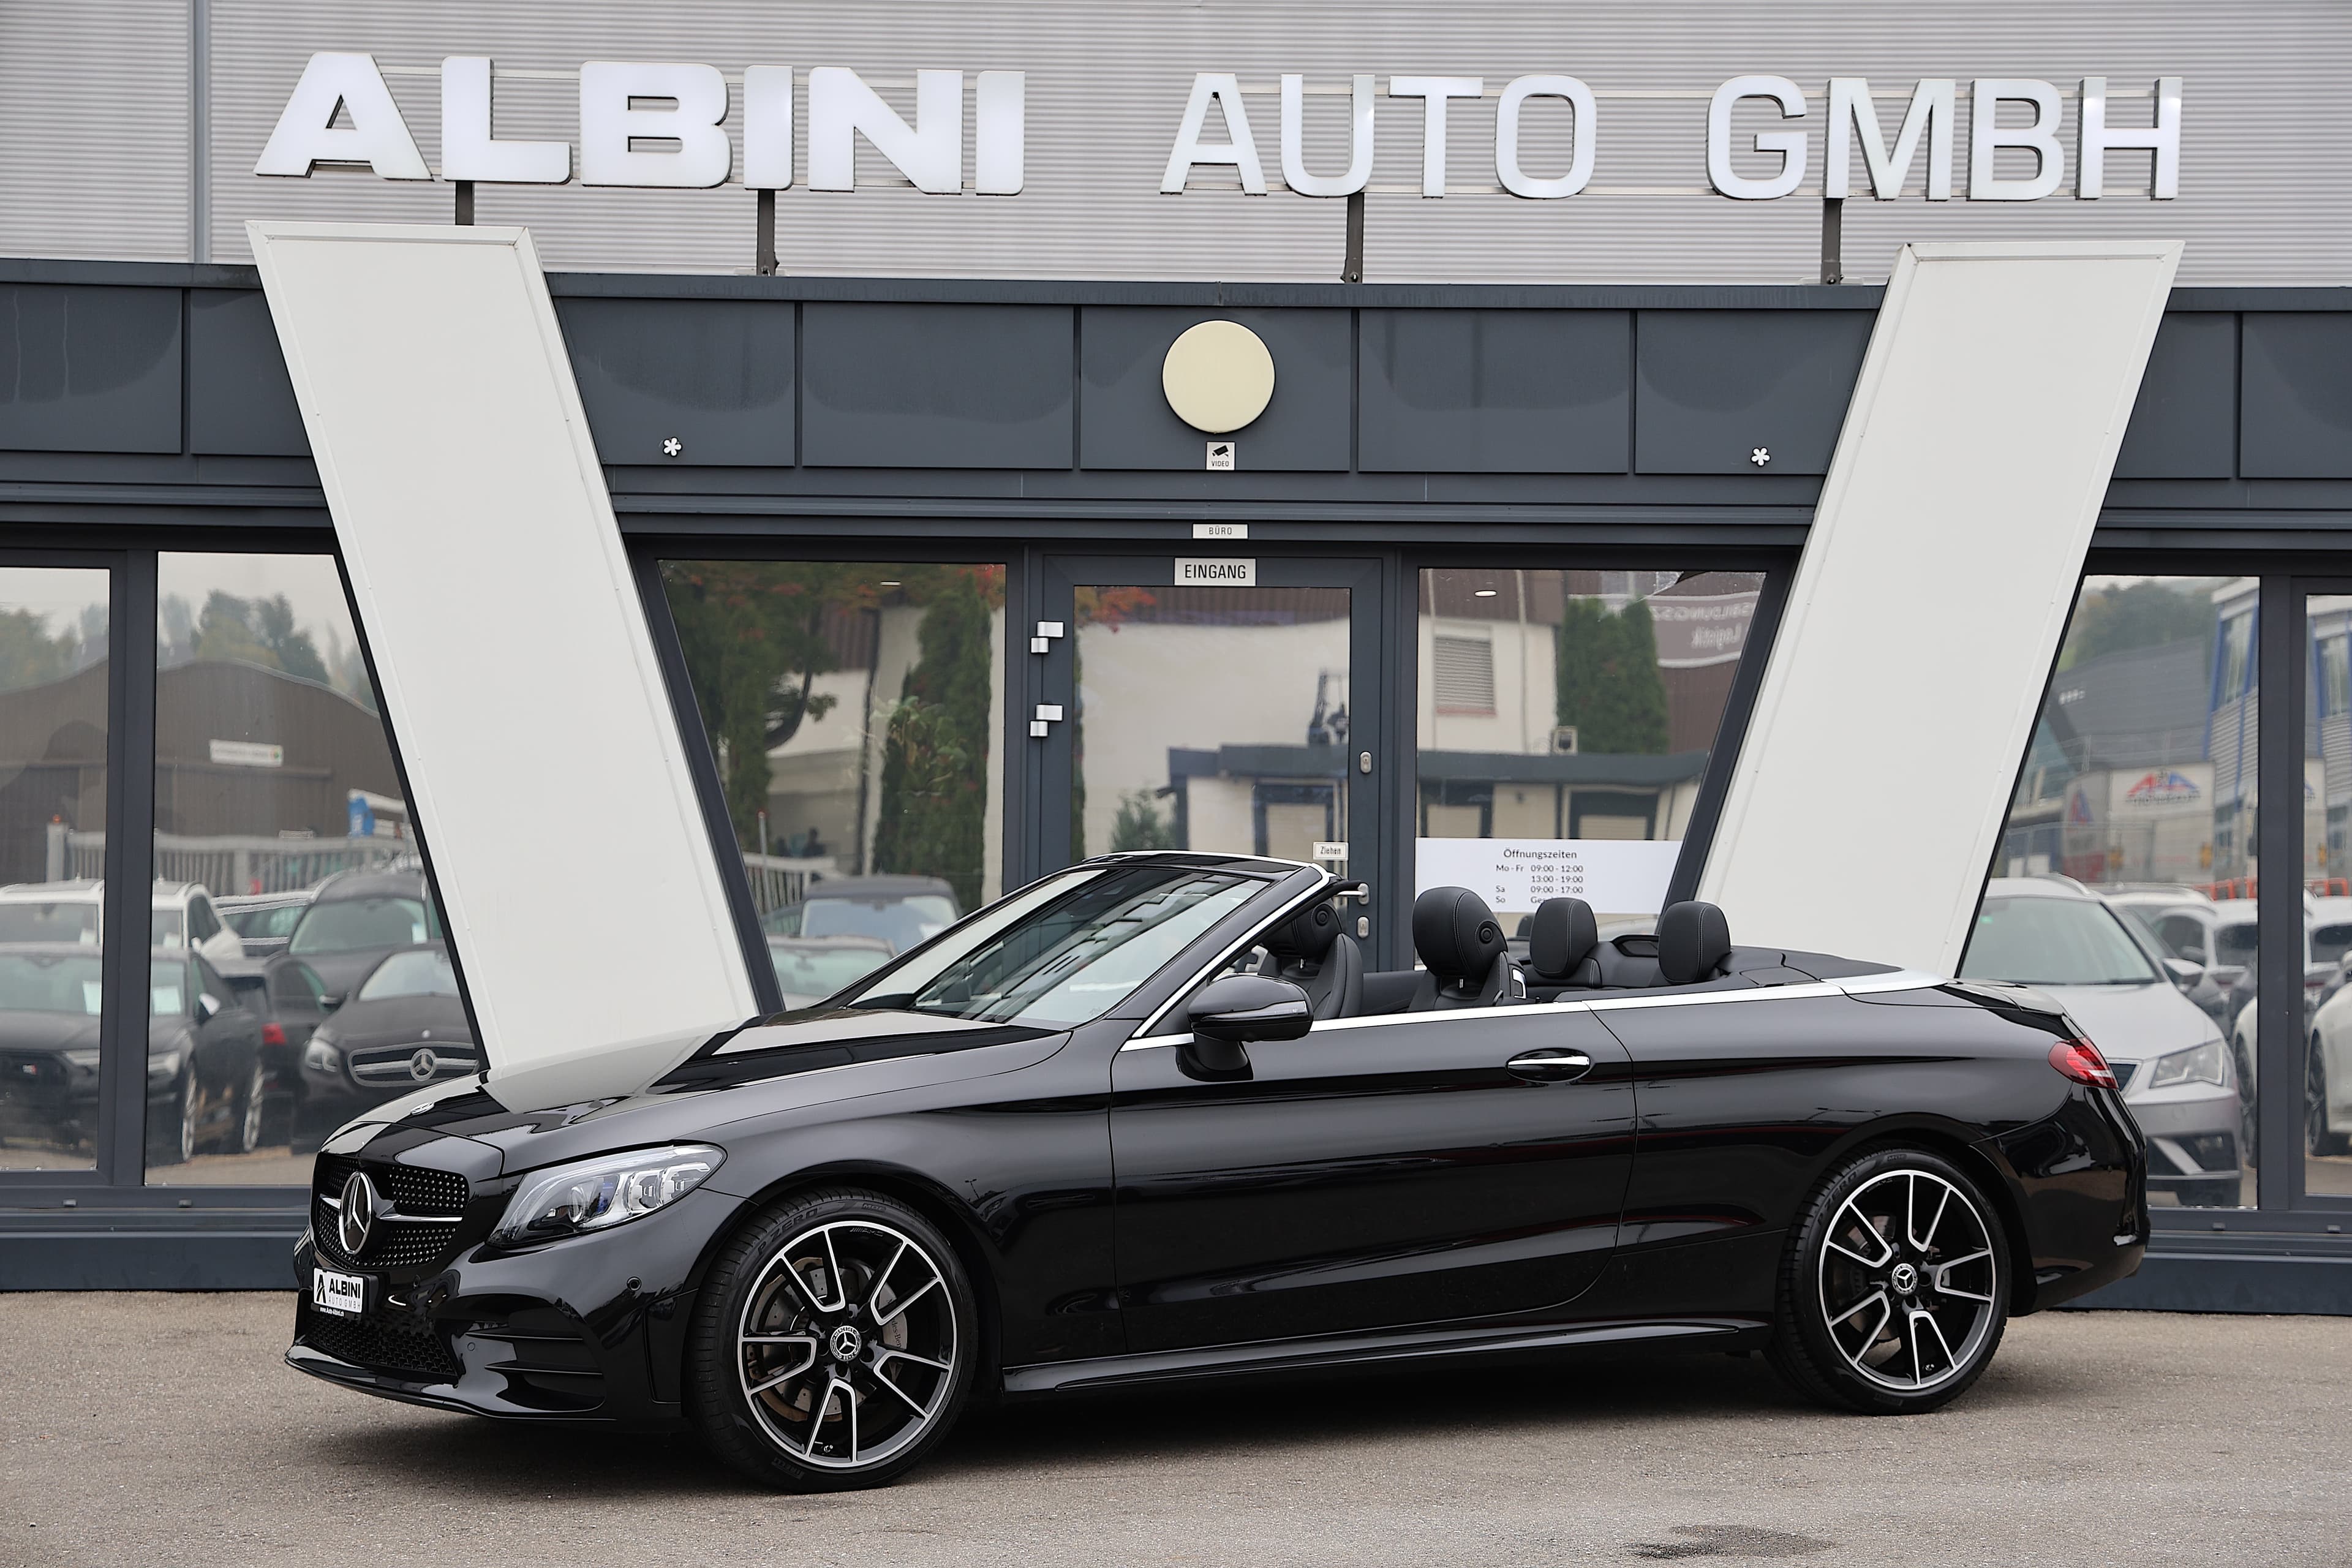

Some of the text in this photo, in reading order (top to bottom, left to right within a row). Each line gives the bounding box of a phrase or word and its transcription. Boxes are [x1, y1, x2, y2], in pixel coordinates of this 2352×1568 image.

[253, 51, 2182, 202] ALBINI AUTO GMBH
[1208, 526, 1232, 535] BÜRO
[1185, 564, 1246, 579] EINGANG
[1320, 846, 1341, 854] Ziehen
[1503, 848, 1577, 859] Öffnungszeiten
[771, 1208, 818, 1242] ZERO
[329, 1278, 360, 1298] ALBINI
[328, 1296, 360, 1310] AUTO GMBH
